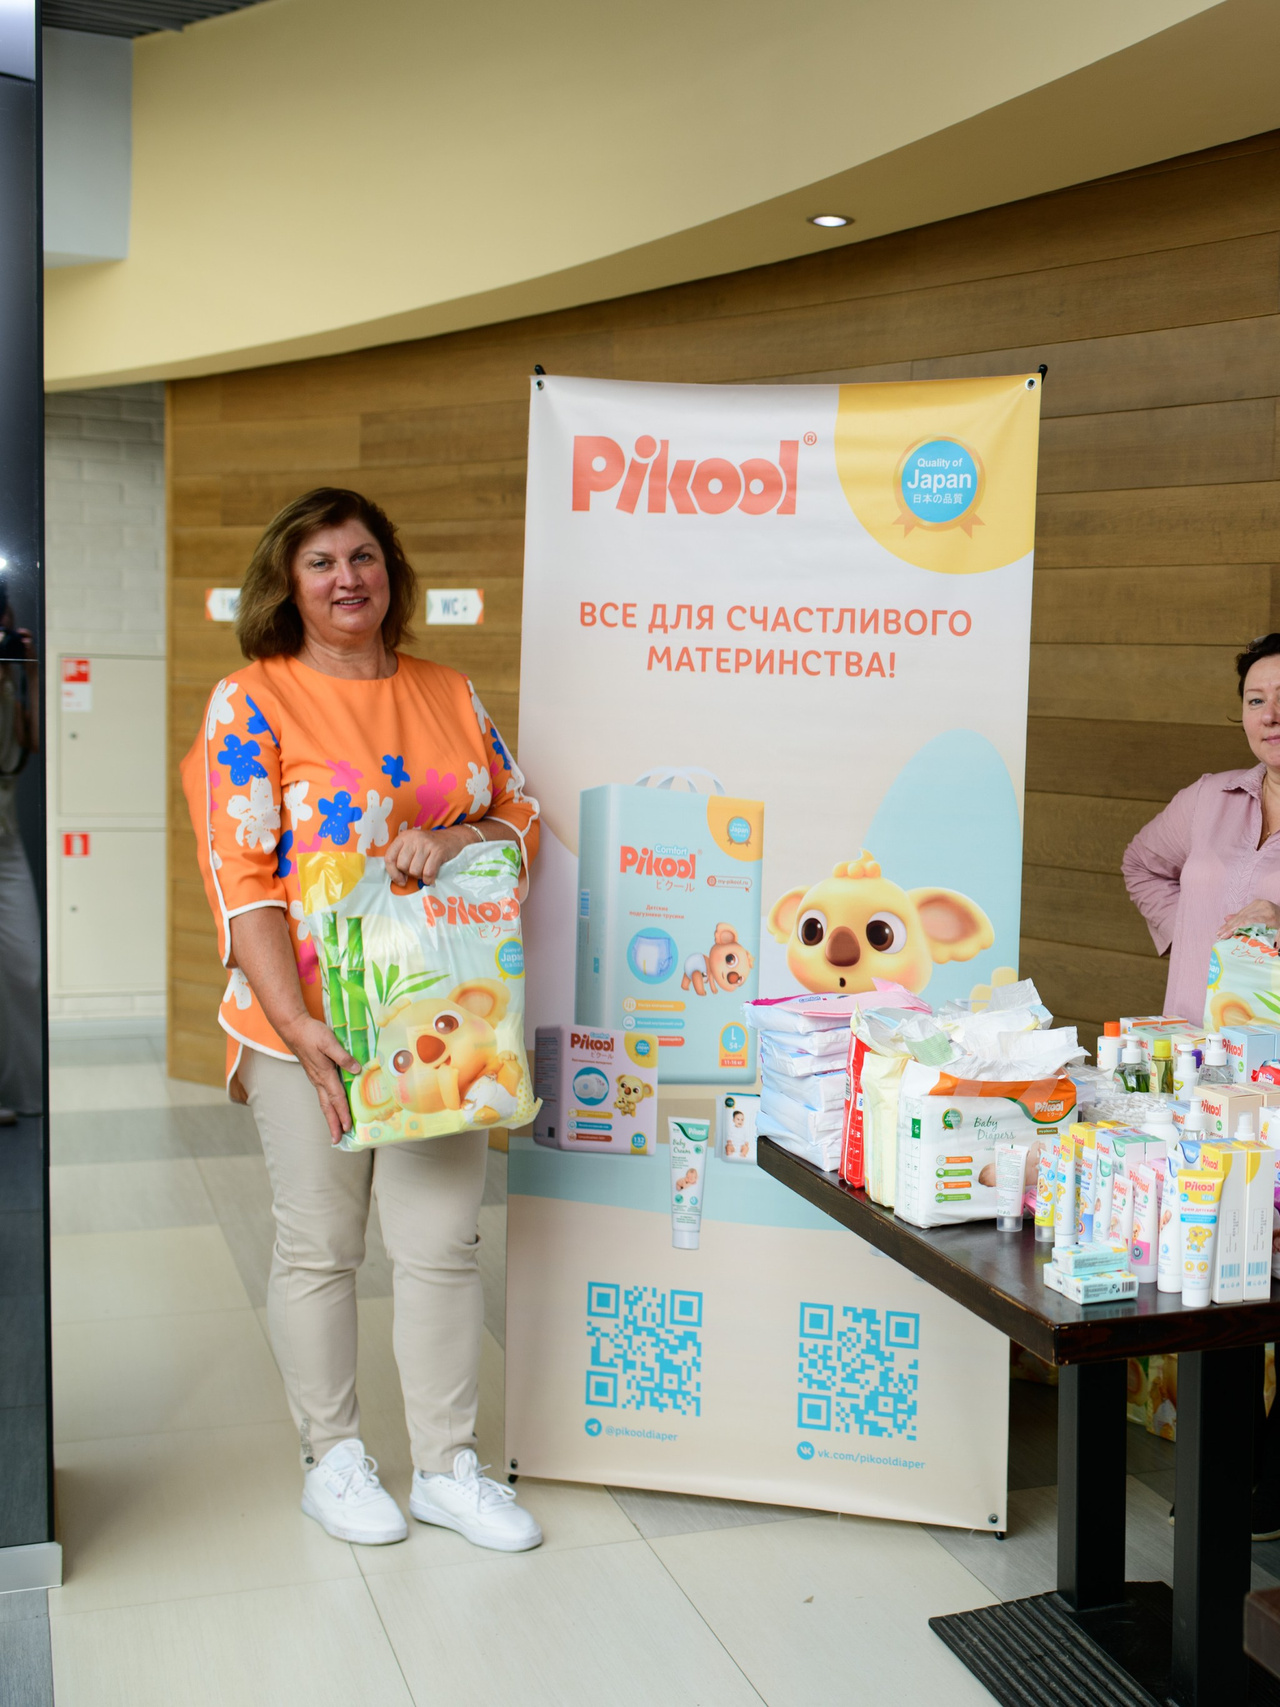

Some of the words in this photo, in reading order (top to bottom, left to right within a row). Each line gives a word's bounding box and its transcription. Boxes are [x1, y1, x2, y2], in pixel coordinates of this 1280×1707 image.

[917, 458, 950, 469] Quality
[952, 458, 963, 467] of
[572, 434, 799, 515] Pikool
[907, 469, 971, 493] Japan
[913, 493, 963, 504] 日本の品質
[579, 602, 637, 629] ВСЕ
[648, 603, 714, 634] ДЛЯ
[726, 605, 972, 637] СЧАСТЛИВОГО
[647, 645, 896, 679] МАТЕРИНСТВА!
[655, 844, 688, 856] Comfort
[620, 845, 696, 880] Pikool
[571, 1033, 614, 1053] Pikool
[1034, 1100, 1064, 1113] Pikool
[974, 1116, 998, 1131] Baby
[977, 1129, 1016, 1144] Diapers
[1184, 1181, 1215, 1192] Pikool
[605, 1424, 679, 1442] @pikooldiaper
[817, 1448, 925, 1470] vk.com/pikooldiaper
